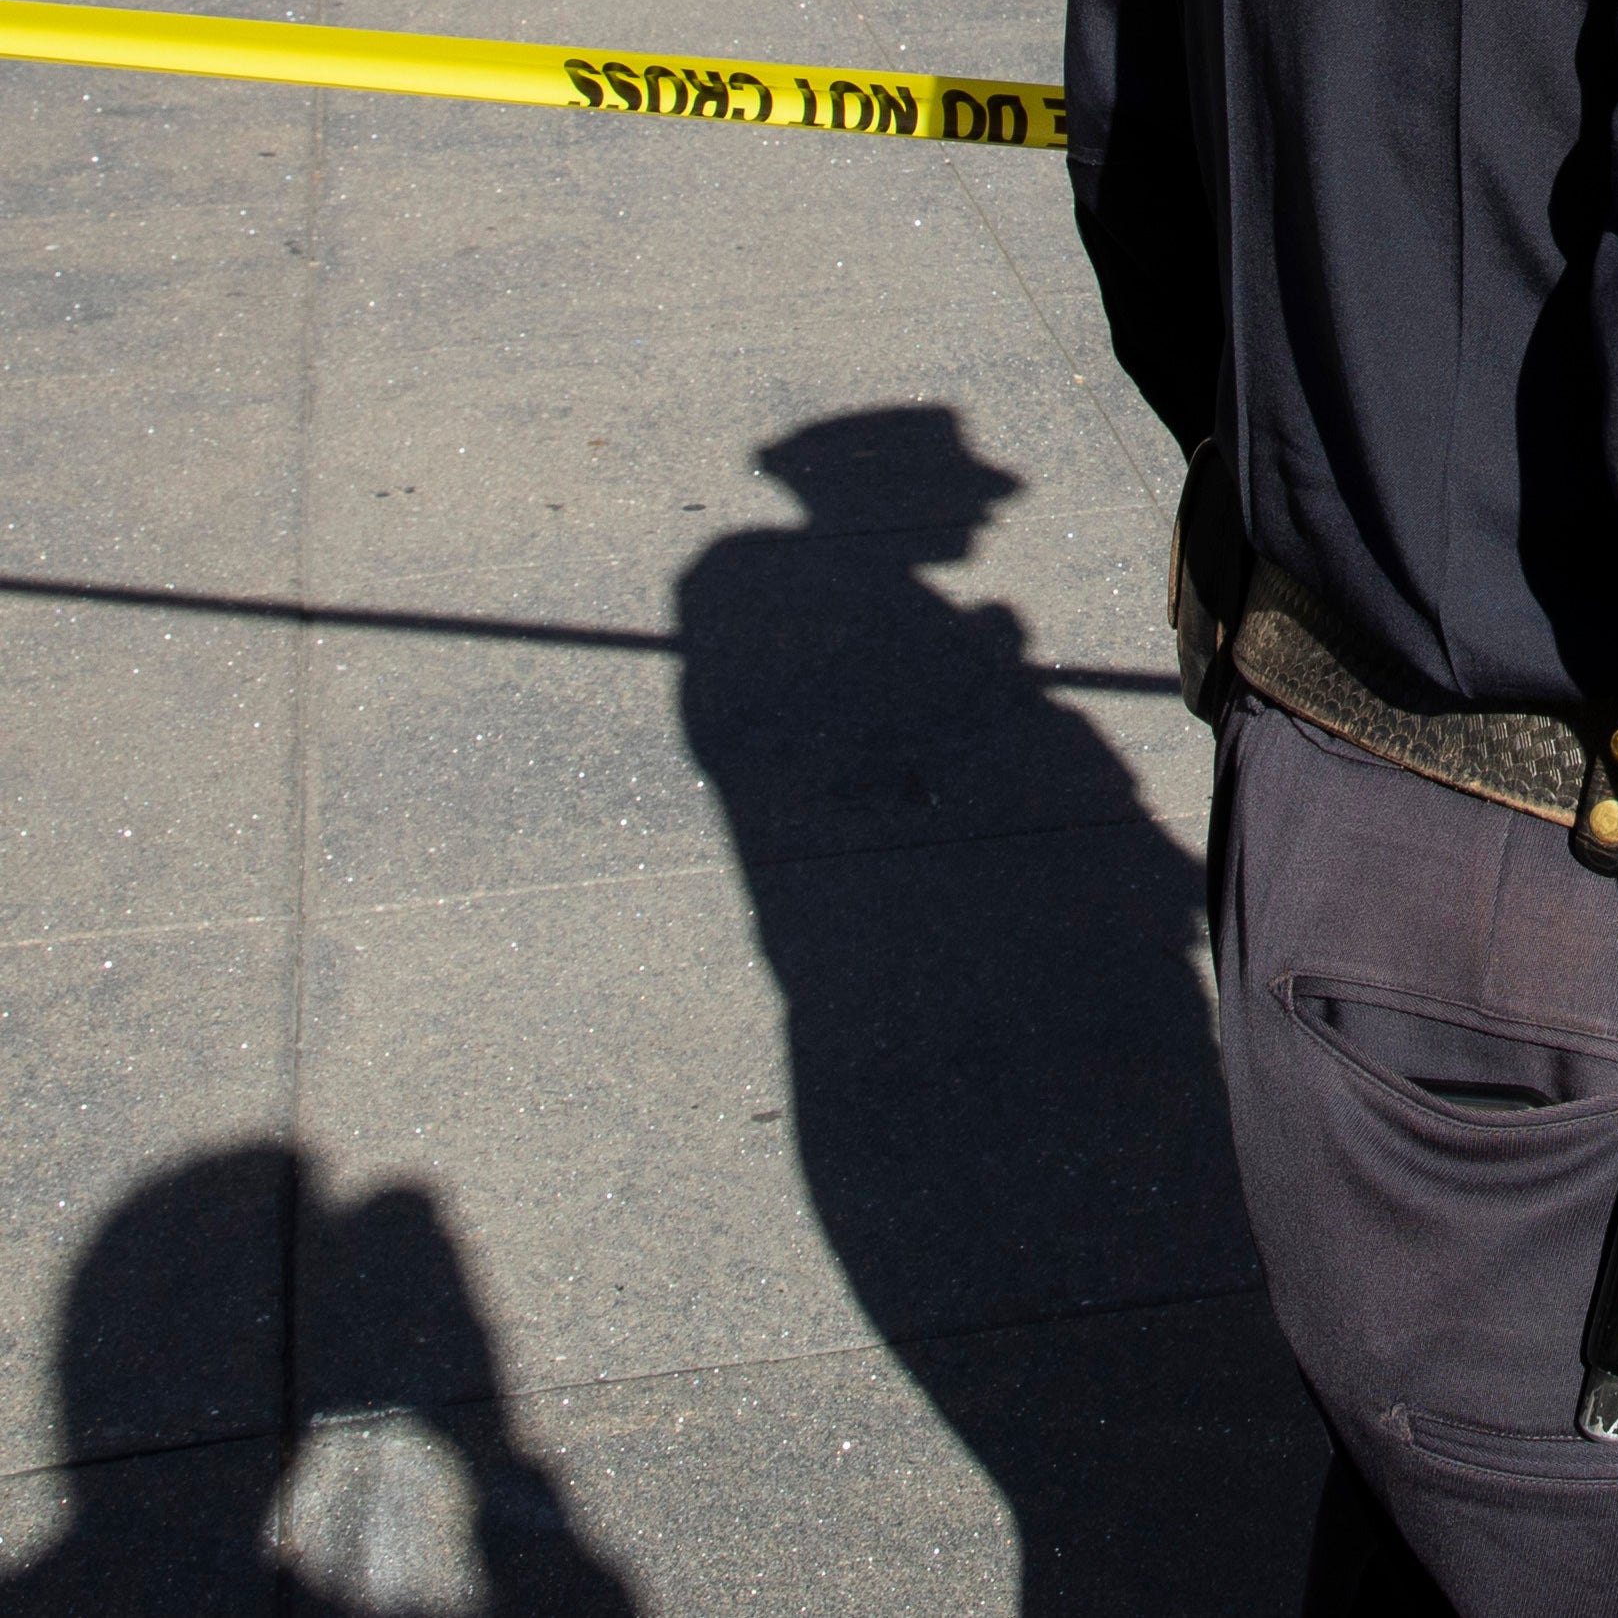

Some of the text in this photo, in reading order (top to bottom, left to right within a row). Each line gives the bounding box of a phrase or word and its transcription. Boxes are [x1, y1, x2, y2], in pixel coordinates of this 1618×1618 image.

[562, 57, 774, 124] CROSS
[787, 76, 918, 138] NOT
[940, 88, 1029, 144] DO
